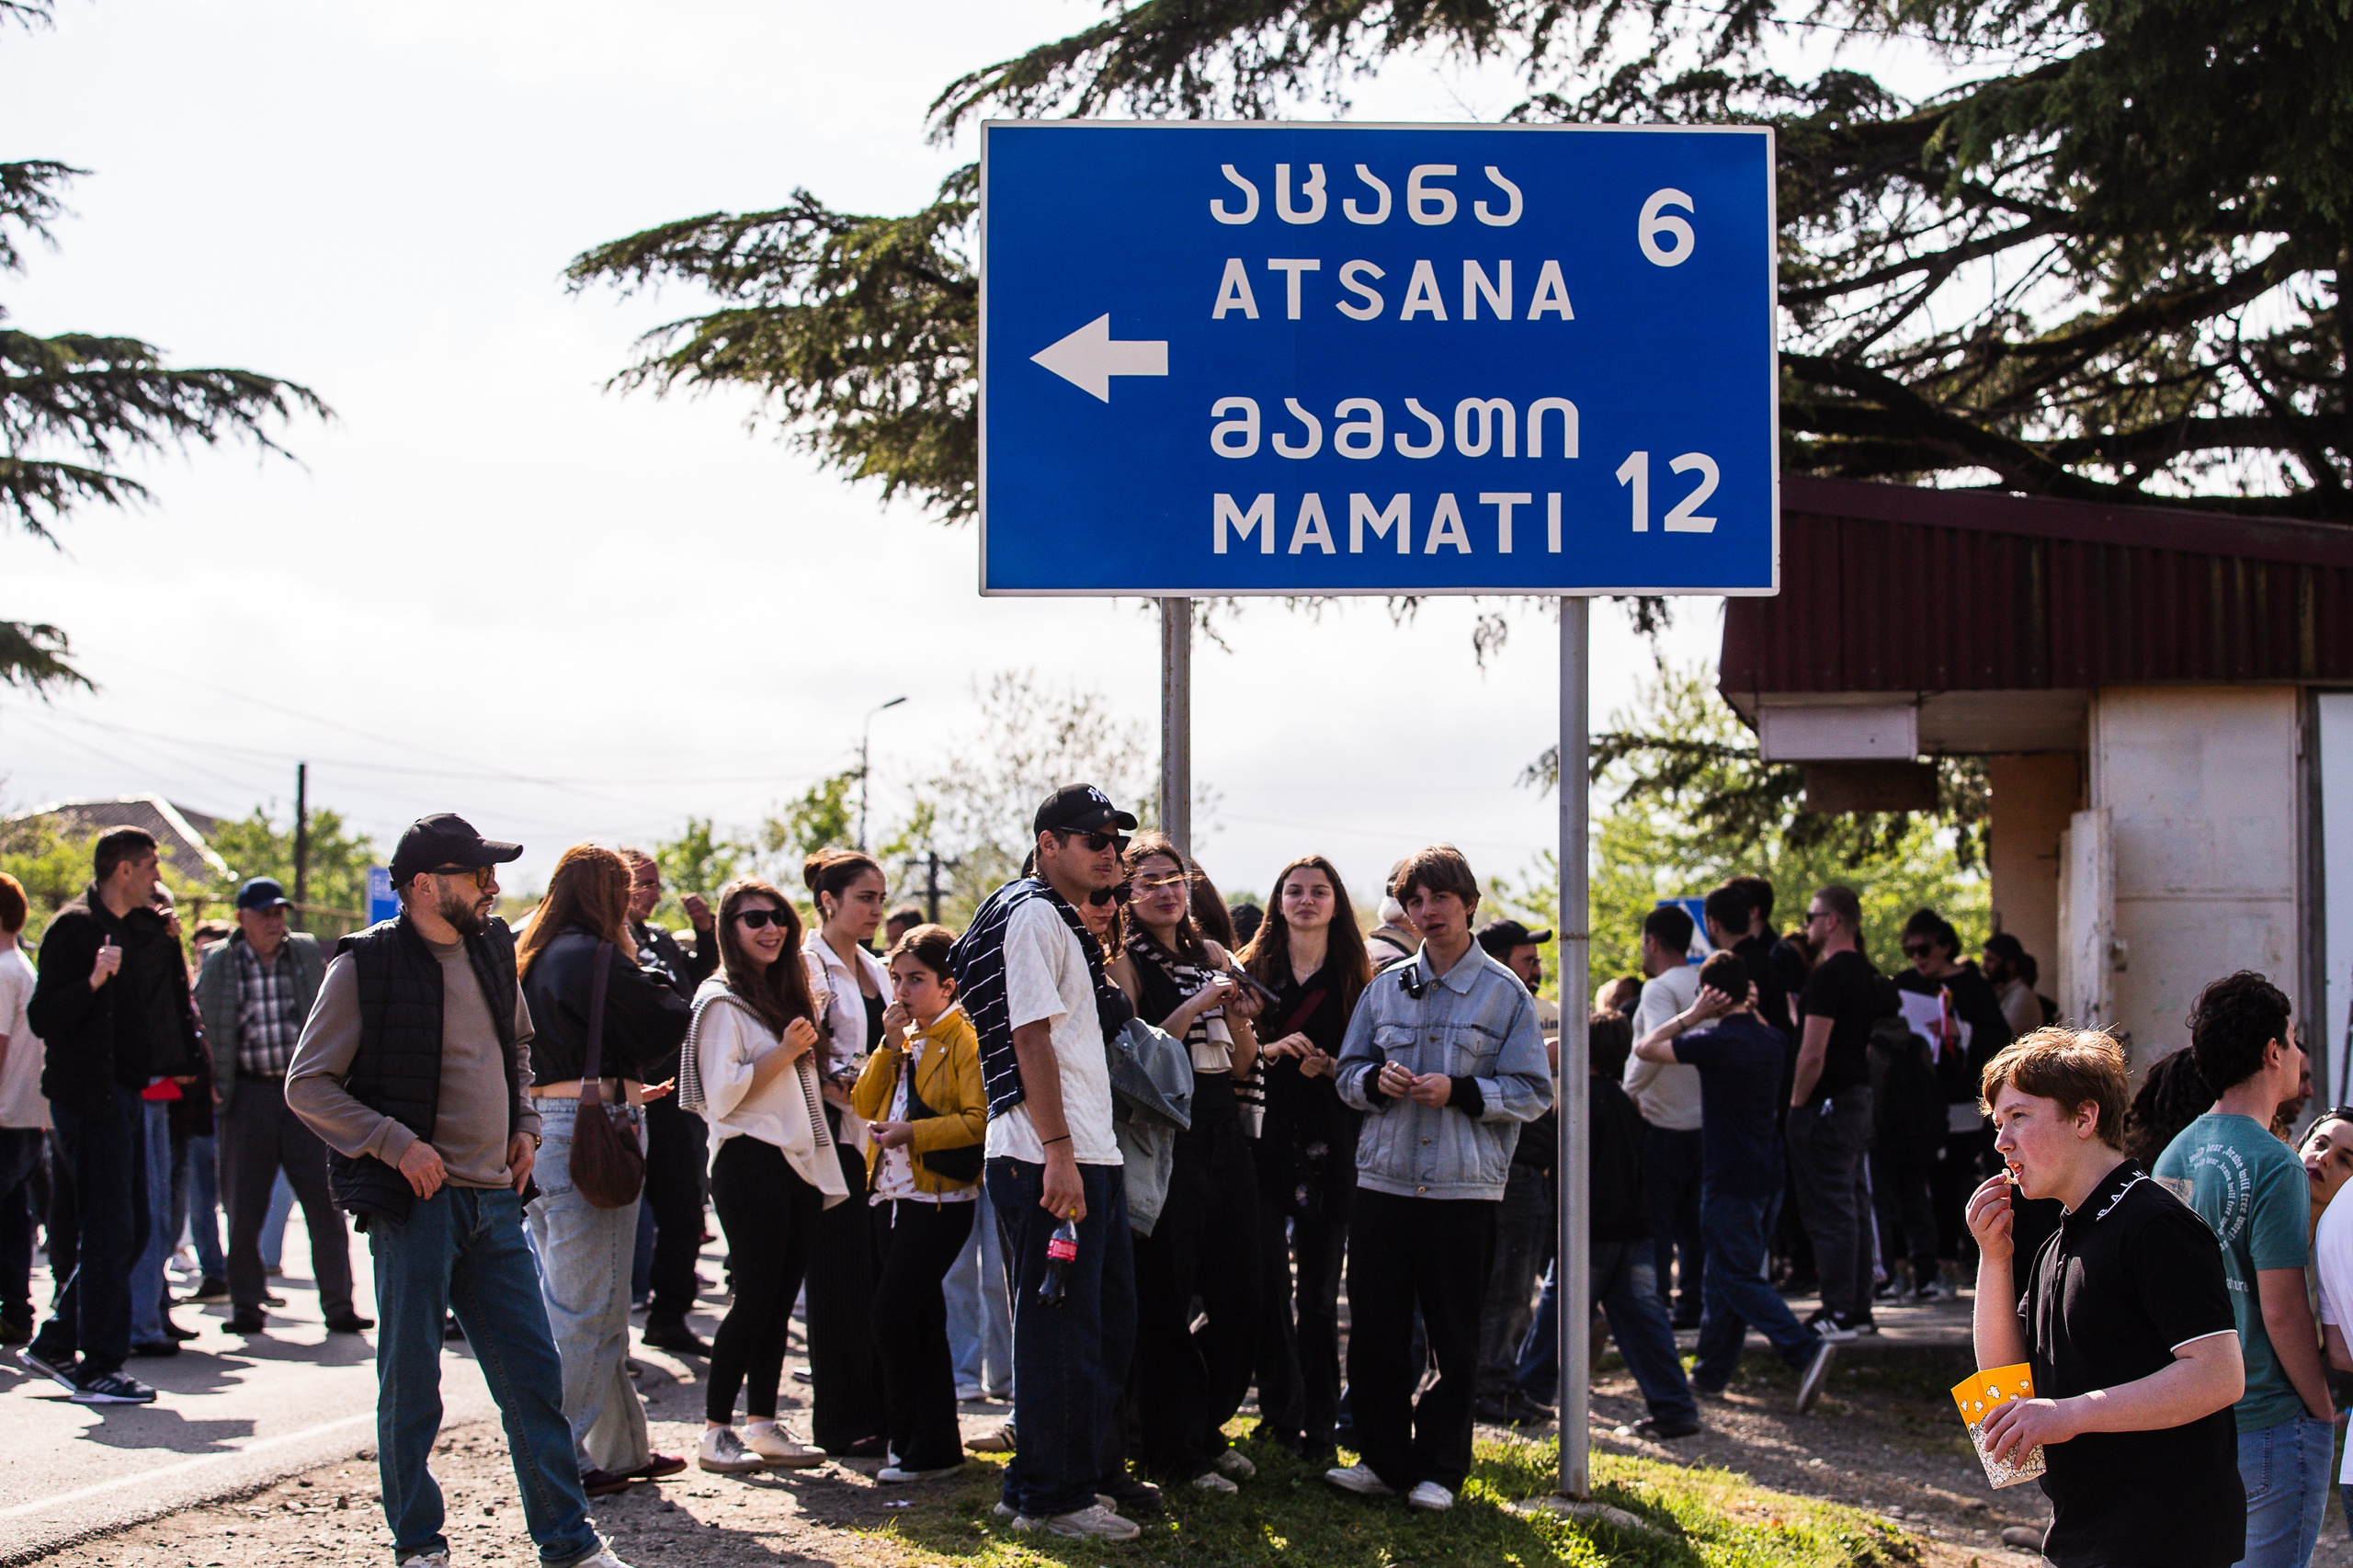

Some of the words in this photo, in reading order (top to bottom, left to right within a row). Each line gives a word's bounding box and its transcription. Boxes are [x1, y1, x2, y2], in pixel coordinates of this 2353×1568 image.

[1210, 164, 1524, 227] აცანა
[1638, 188, 1695, 267] 6
[1211, 258, 1575, 321] ATSANA
[1210, 397, 1579, 460] მამათი
[1213, 493, 1562, 554] MAMATI
[1615, 451, 1720, 533] 12
[2239, 1168, 2251, 1191] will
[2240, 1193, 2251, 1214] free
